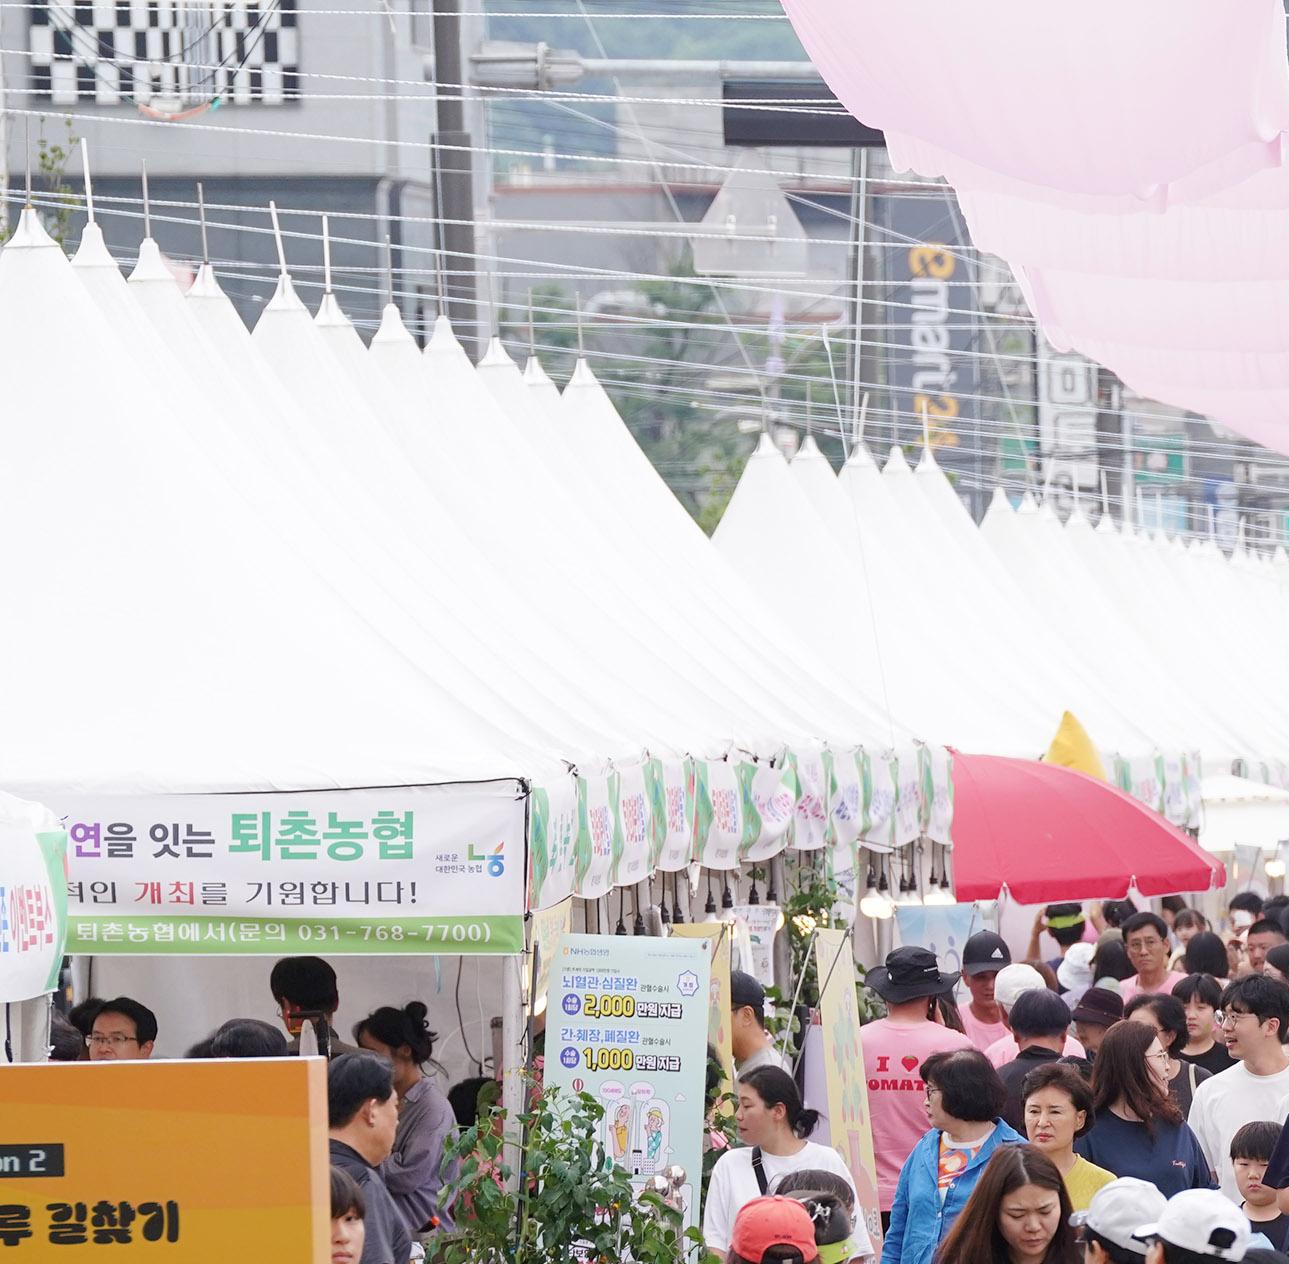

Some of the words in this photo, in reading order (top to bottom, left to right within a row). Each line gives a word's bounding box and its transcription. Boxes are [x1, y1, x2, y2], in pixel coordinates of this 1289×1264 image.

[149, 822, 216, 859] 잇는
[228, 810, 415, 862] 퇴촌농협
[435, 853, 458, 863] 새로운
[435, 863, 466, 875] 대한민국
[134, 881, 228, 906] 개최를
[246, 881, 417, 906] 기원합니다!
[76, 921, 287, 944] 퇴촌농협에서(문의
[297, 924, 492, 943] 031-768-7700)
[584, 994, 635, 1018] 2,000
[637, 1001, 660, 1018] 만원
[660, 1003, 682, 1019] 지급
[583, 1047, 634, 1072] 1,000
[635, 1055, 658, 1071] 만원
[658, 1056, 681, 1072] 지급
[876, 1056, 890, 1072] I
[868, 1079, 926, 1092] OMAT
[29, 1149, 46, 1172] 2
[46, 1200, 180, 1245] 길찾기
